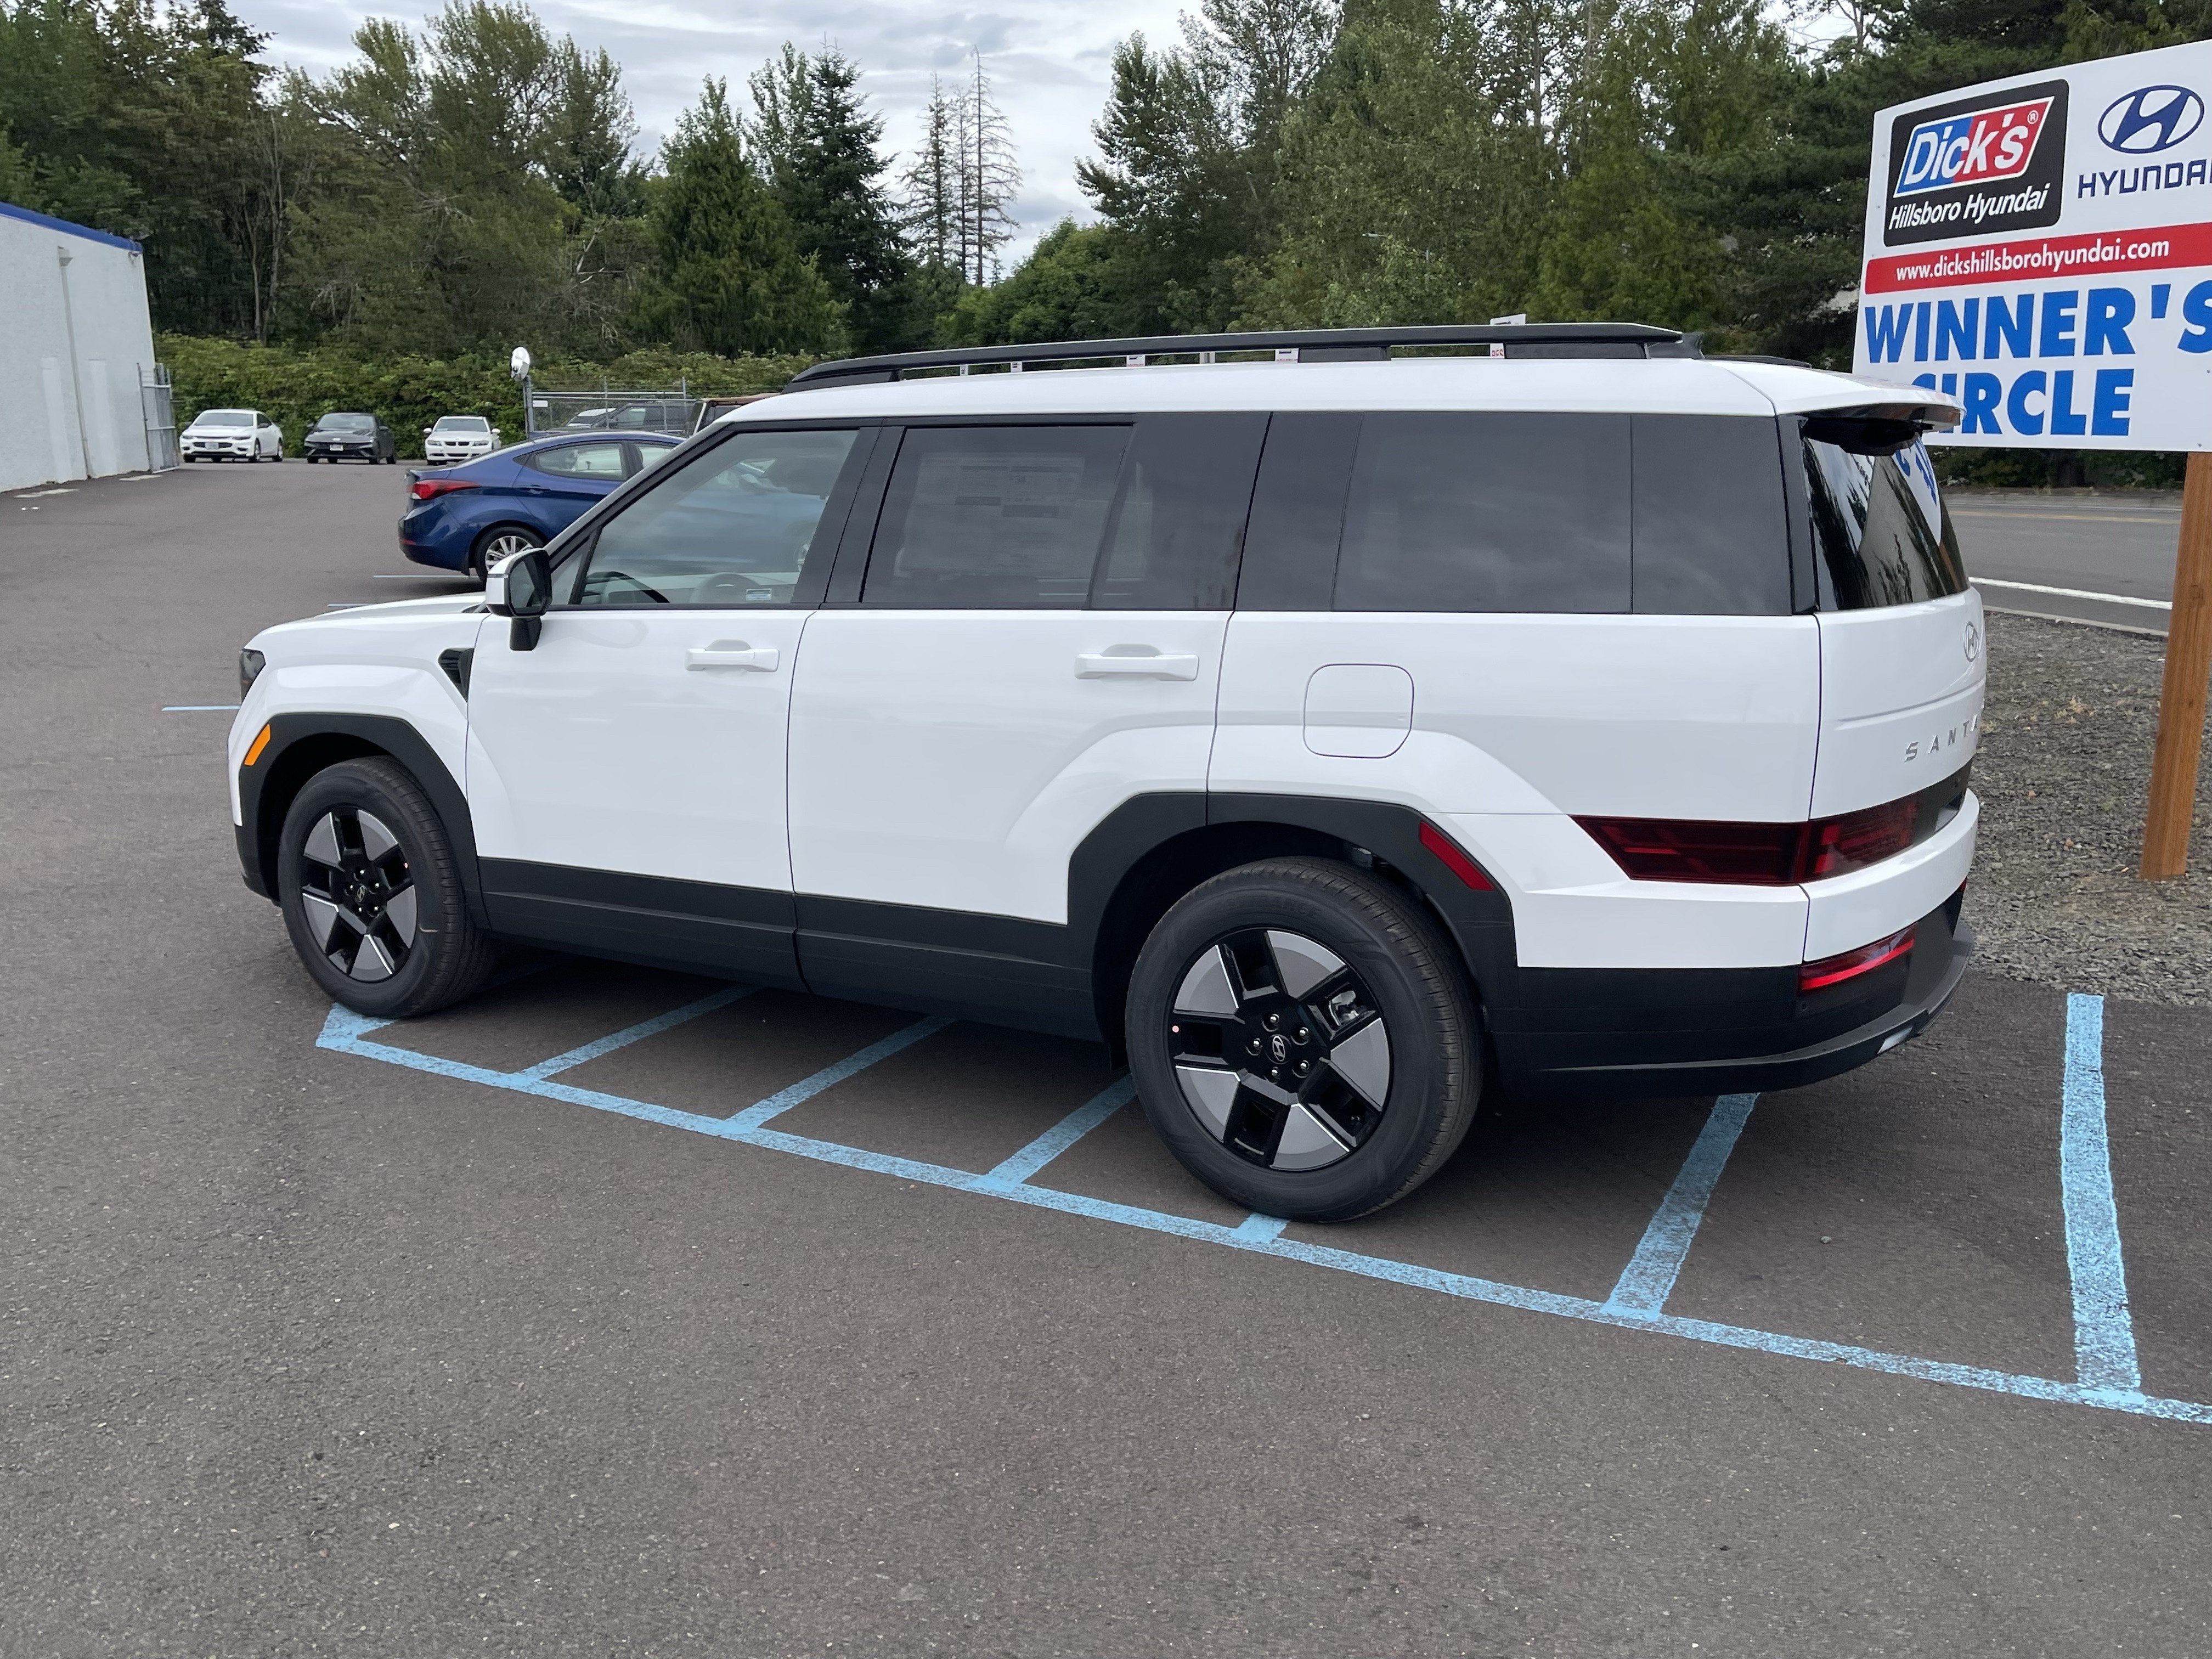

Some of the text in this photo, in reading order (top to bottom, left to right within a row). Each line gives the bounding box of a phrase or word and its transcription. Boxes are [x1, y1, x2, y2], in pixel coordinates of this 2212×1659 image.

[1888, 183, 2050, 230] Hillsboro Hyundai
[1895, 237, 2170, 281] www.dickshillsborohyundai.com
[1865, 279, 2212, 364] WINNER'S
[1911, 368, 2135, 436] RCLE
